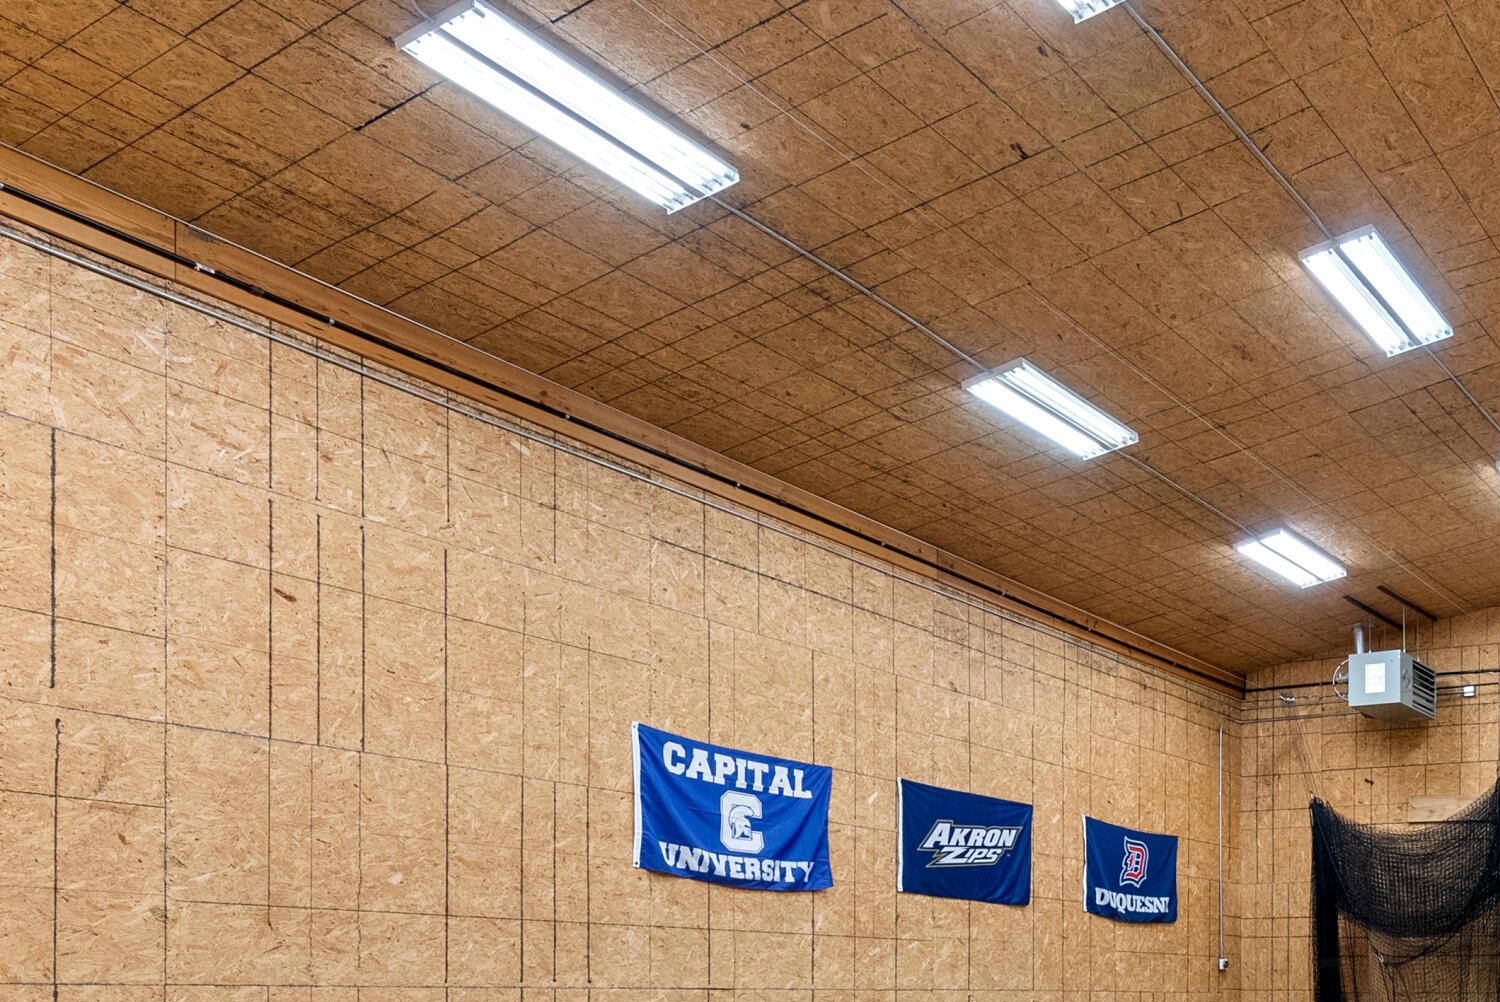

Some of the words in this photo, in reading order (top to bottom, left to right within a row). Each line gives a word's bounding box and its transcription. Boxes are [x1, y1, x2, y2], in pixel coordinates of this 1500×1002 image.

[662, 741, 813, 799] CAPITAL
[921, 820, 1020, 849] AKRON
[658, 841, 815, 883] UNIVERSITY
[936, 847, 1003, 866] ZIPS
